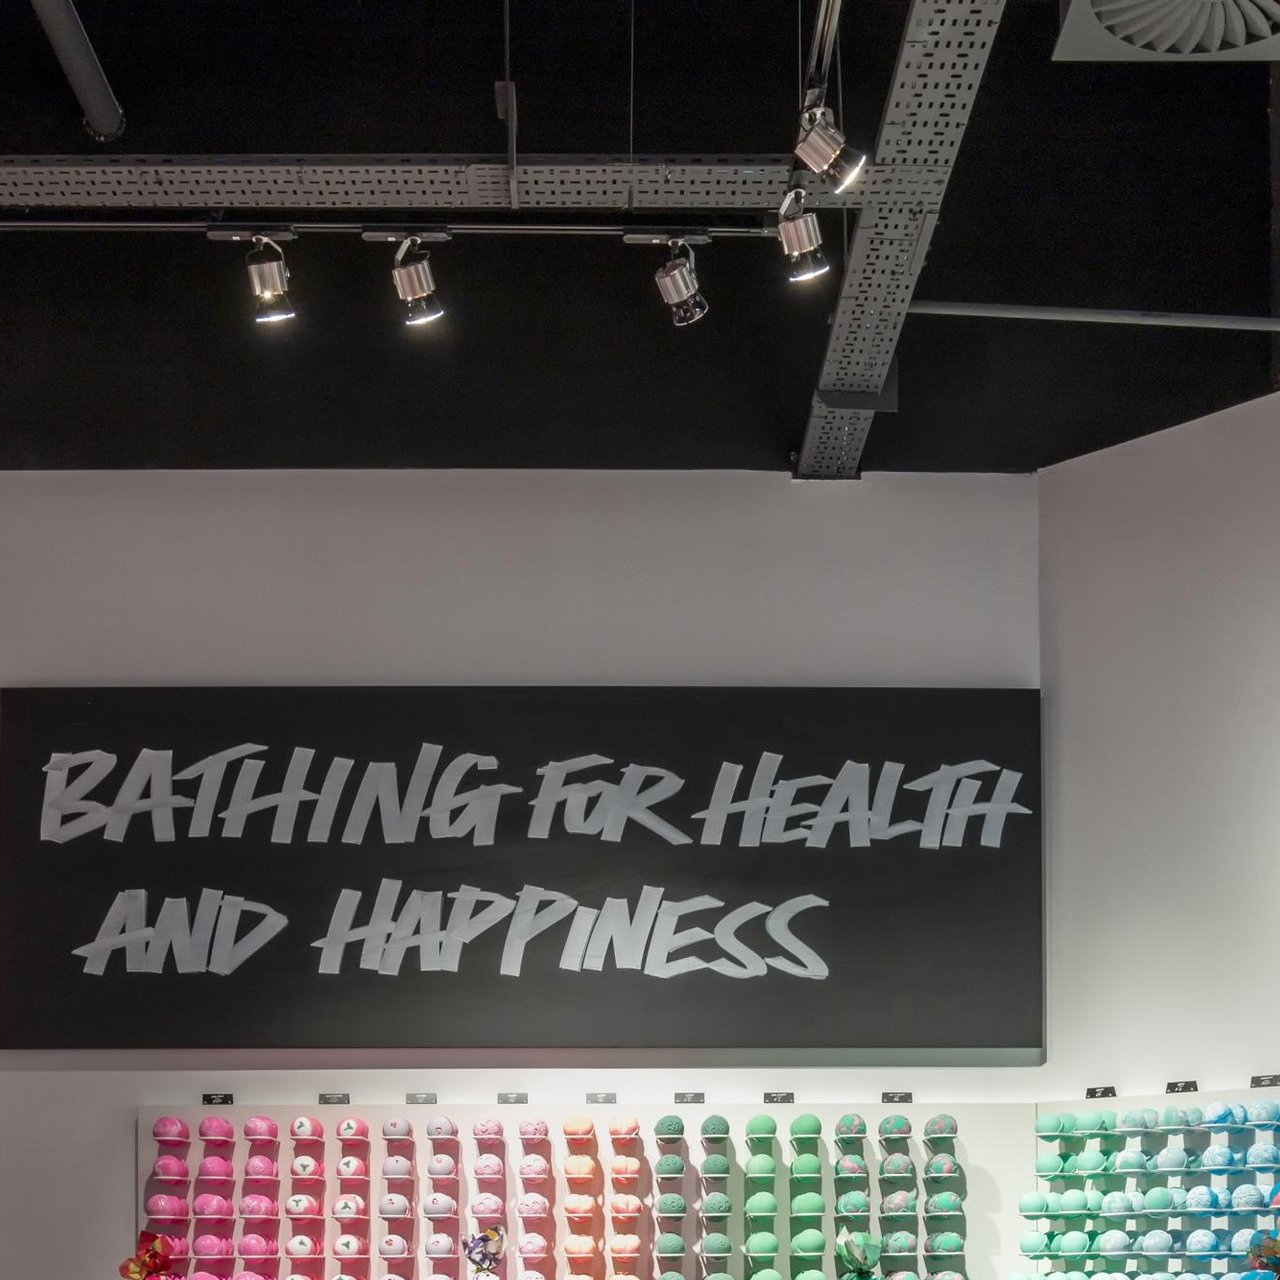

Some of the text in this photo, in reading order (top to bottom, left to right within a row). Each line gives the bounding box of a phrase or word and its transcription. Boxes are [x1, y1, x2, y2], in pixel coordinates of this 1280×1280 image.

[41, 743, 1033, 849] BATHING FOR HEALTH
[72, 878, 830, 980] AND HAPPINESS
